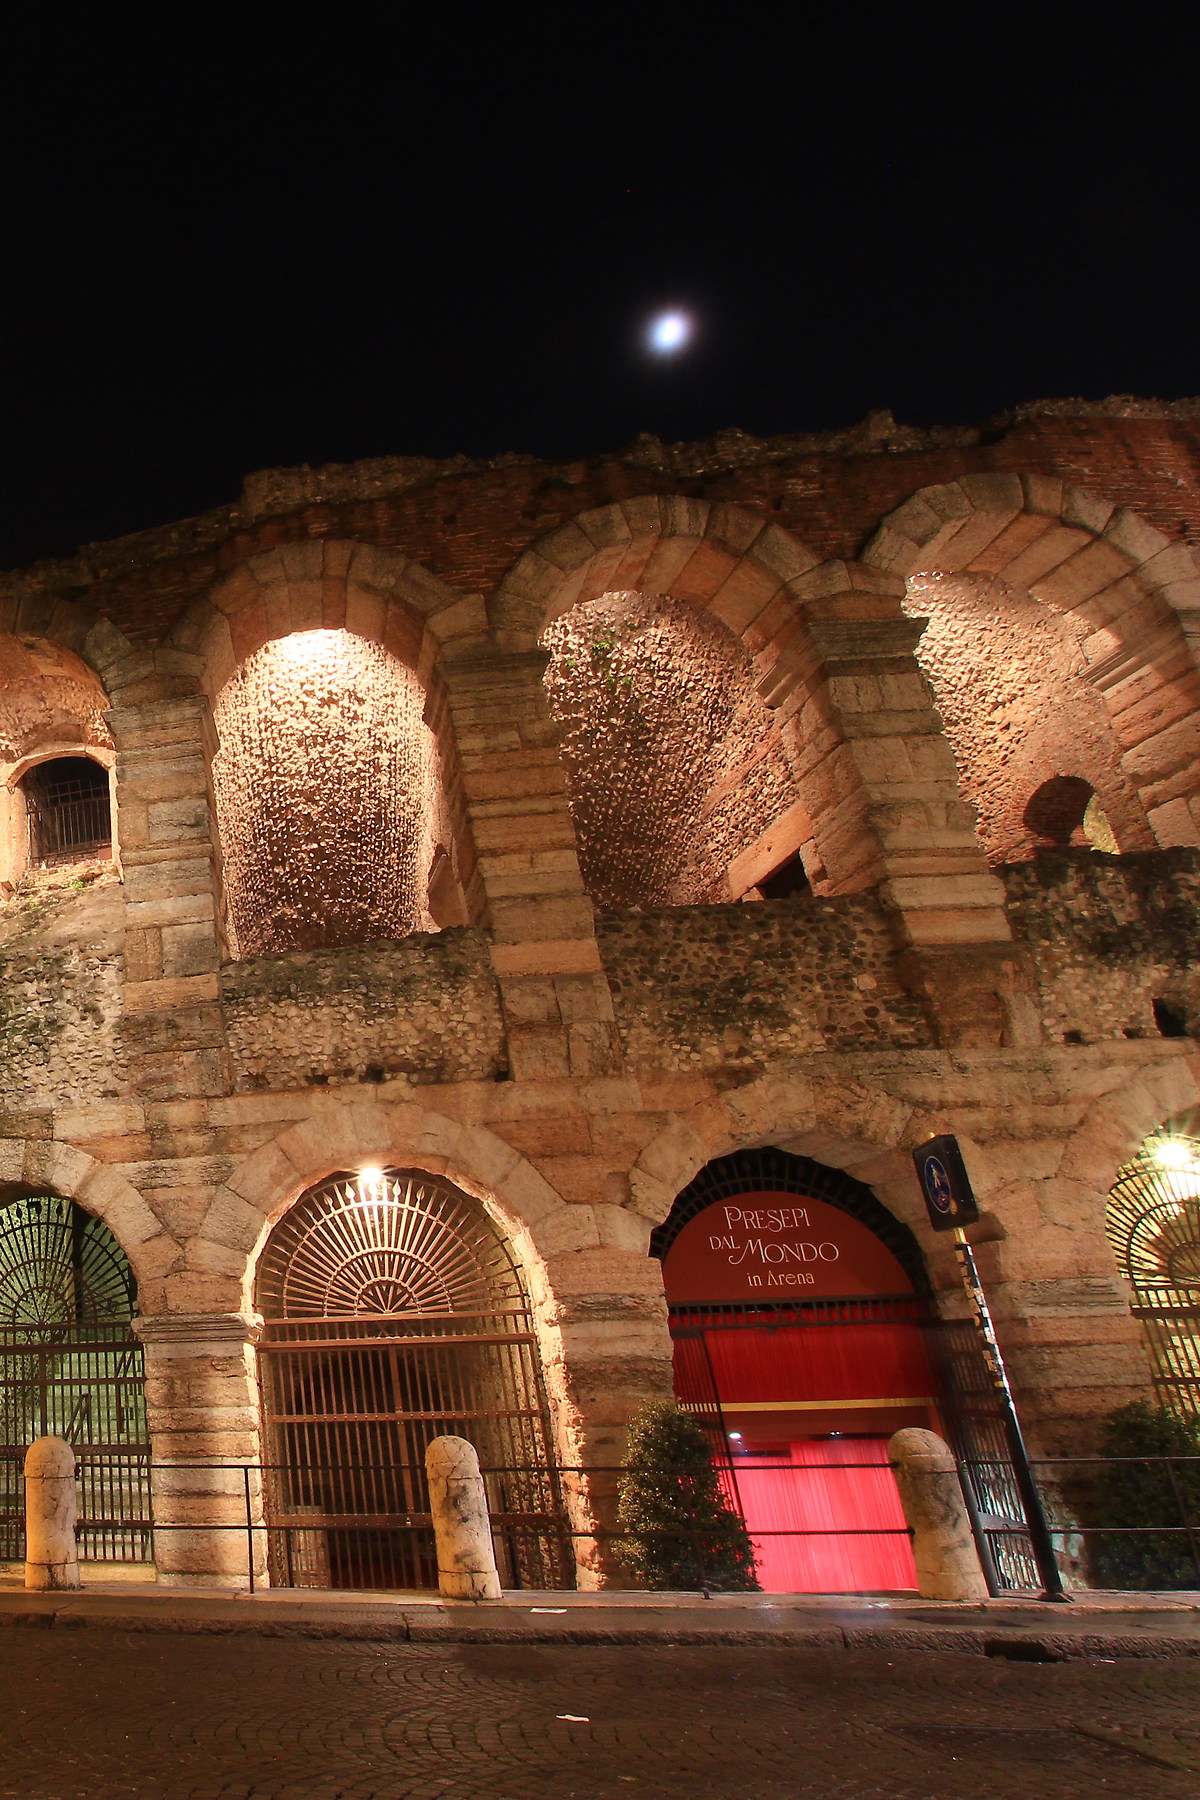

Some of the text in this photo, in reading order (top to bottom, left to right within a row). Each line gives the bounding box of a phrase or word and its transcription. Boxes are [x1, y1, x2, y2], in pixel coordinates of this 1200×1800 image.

[723, 1206, 810, 1232] PRESEPI
[708, 1235, 839, 1265] DAL MONDO
[746, 1270, 815, 1287] in Arena
